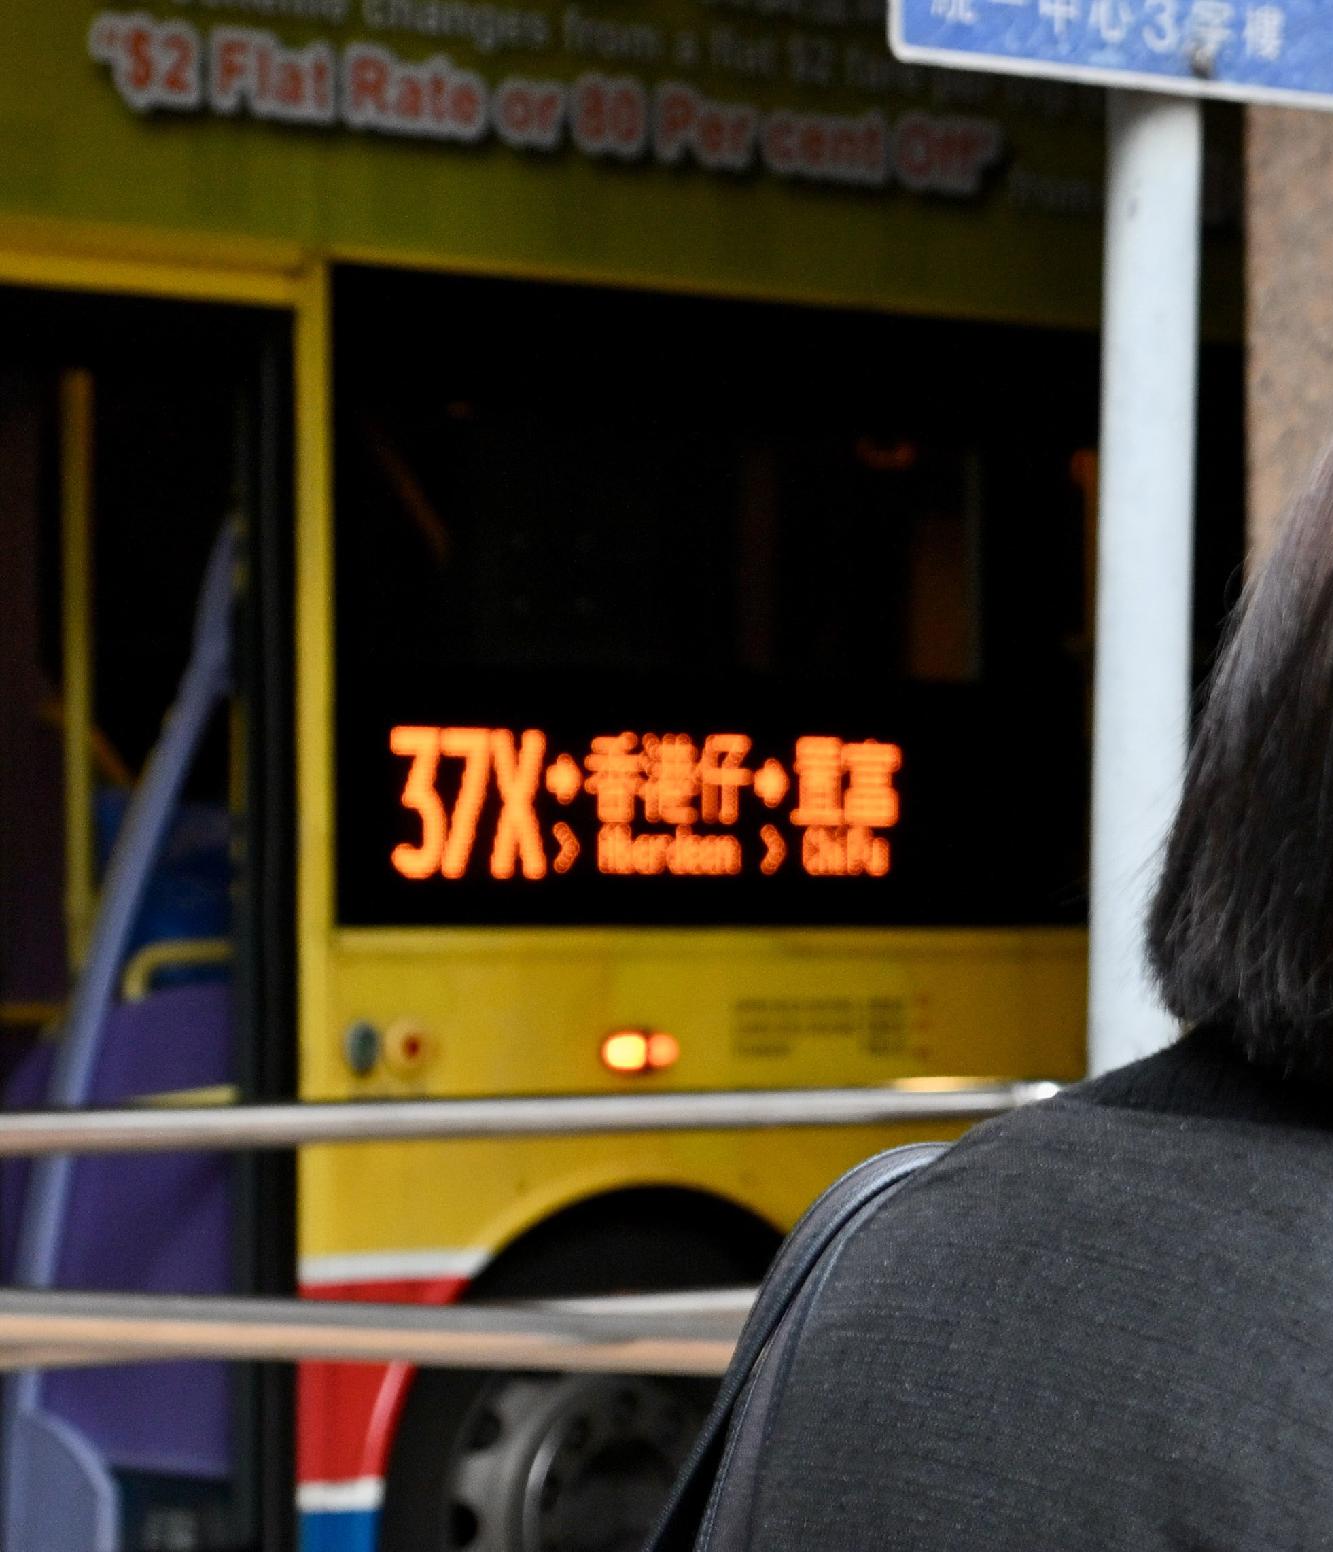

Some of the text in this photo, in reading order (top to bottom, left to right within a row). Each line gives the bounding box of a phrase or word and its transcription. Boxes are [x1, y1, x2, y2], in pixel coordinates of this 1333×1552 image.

[211, 32, 332, 115] Flat
[347, 48, 484, 130] Rate
[498, 81, 562, 140] or
[656, 88, 754, 164] Per
[764, 112, 886, 178] cent
[389, 725, 548, 880] 37X
[583, 731, 753, 825] 香港仔
